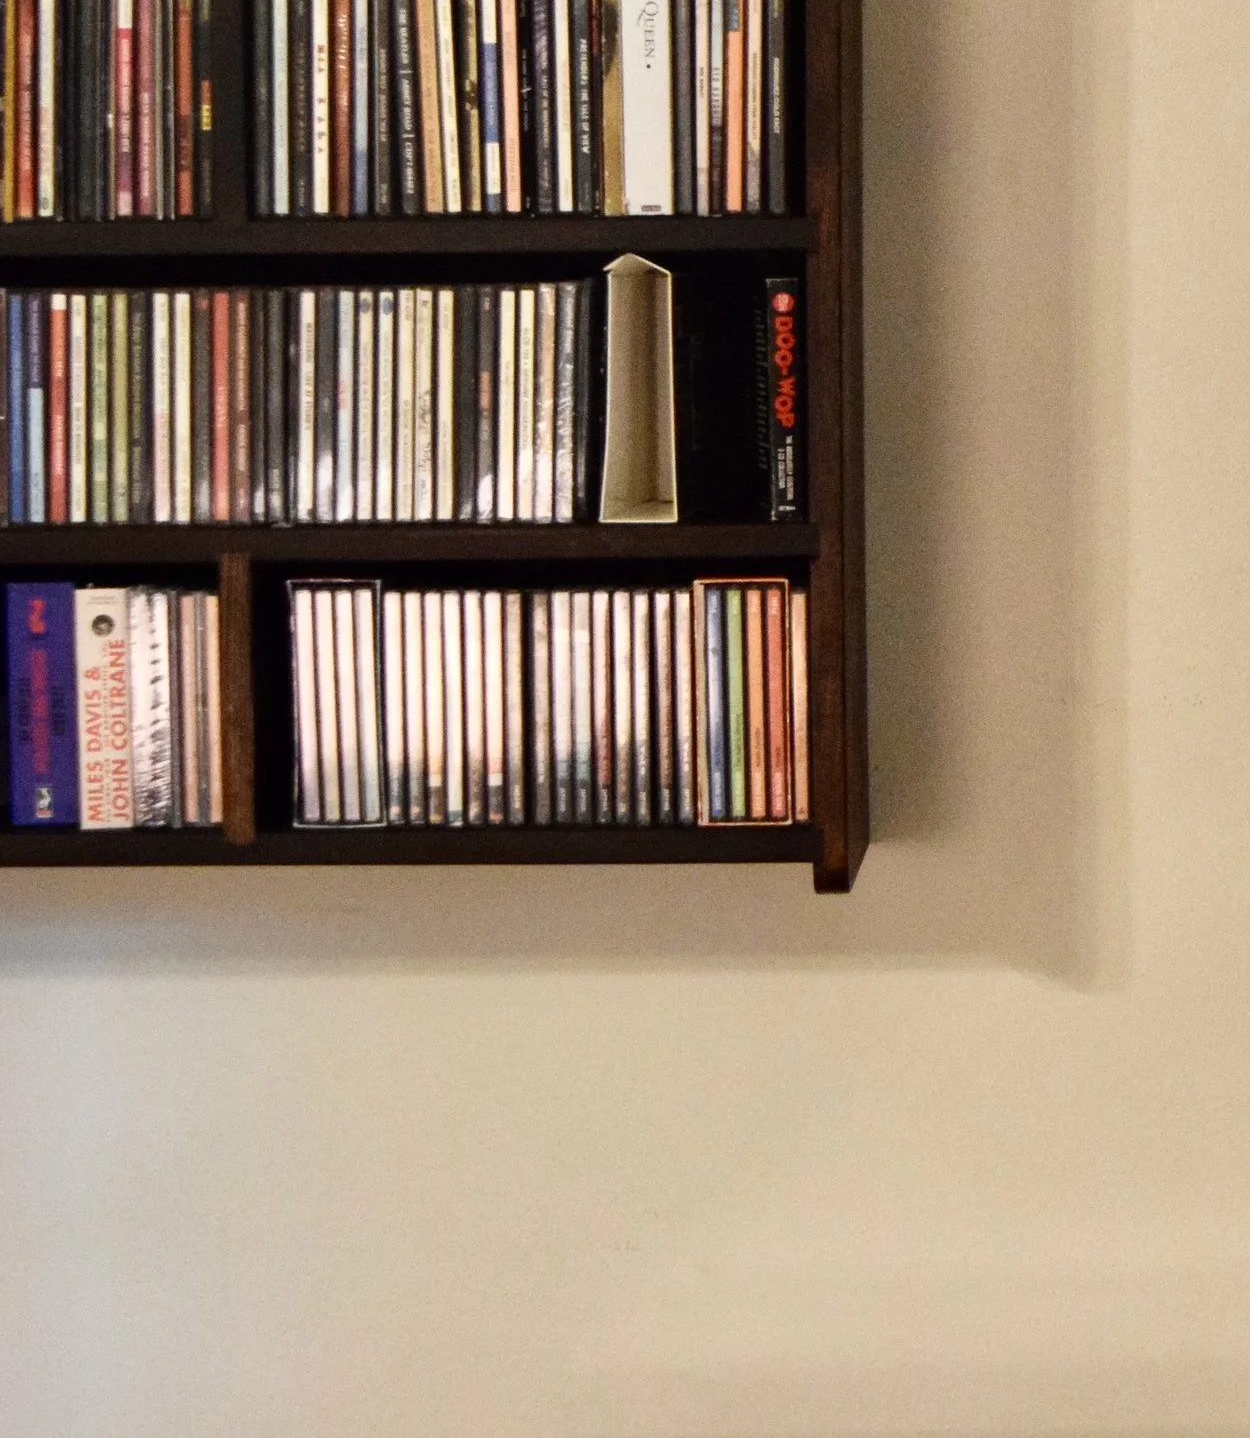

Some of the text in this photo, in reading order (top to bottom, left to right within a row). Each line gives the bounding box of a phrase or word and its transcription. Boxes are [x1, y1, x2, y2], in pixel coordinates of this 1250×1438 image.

[637, 0, 660, 59] QUEEN
[774, 316, 796, 428] DOO-WOP
[83, 666, 104, 822] MILES DAVIS &
[108, 639, 129, 821] JOHN COLTRANE
